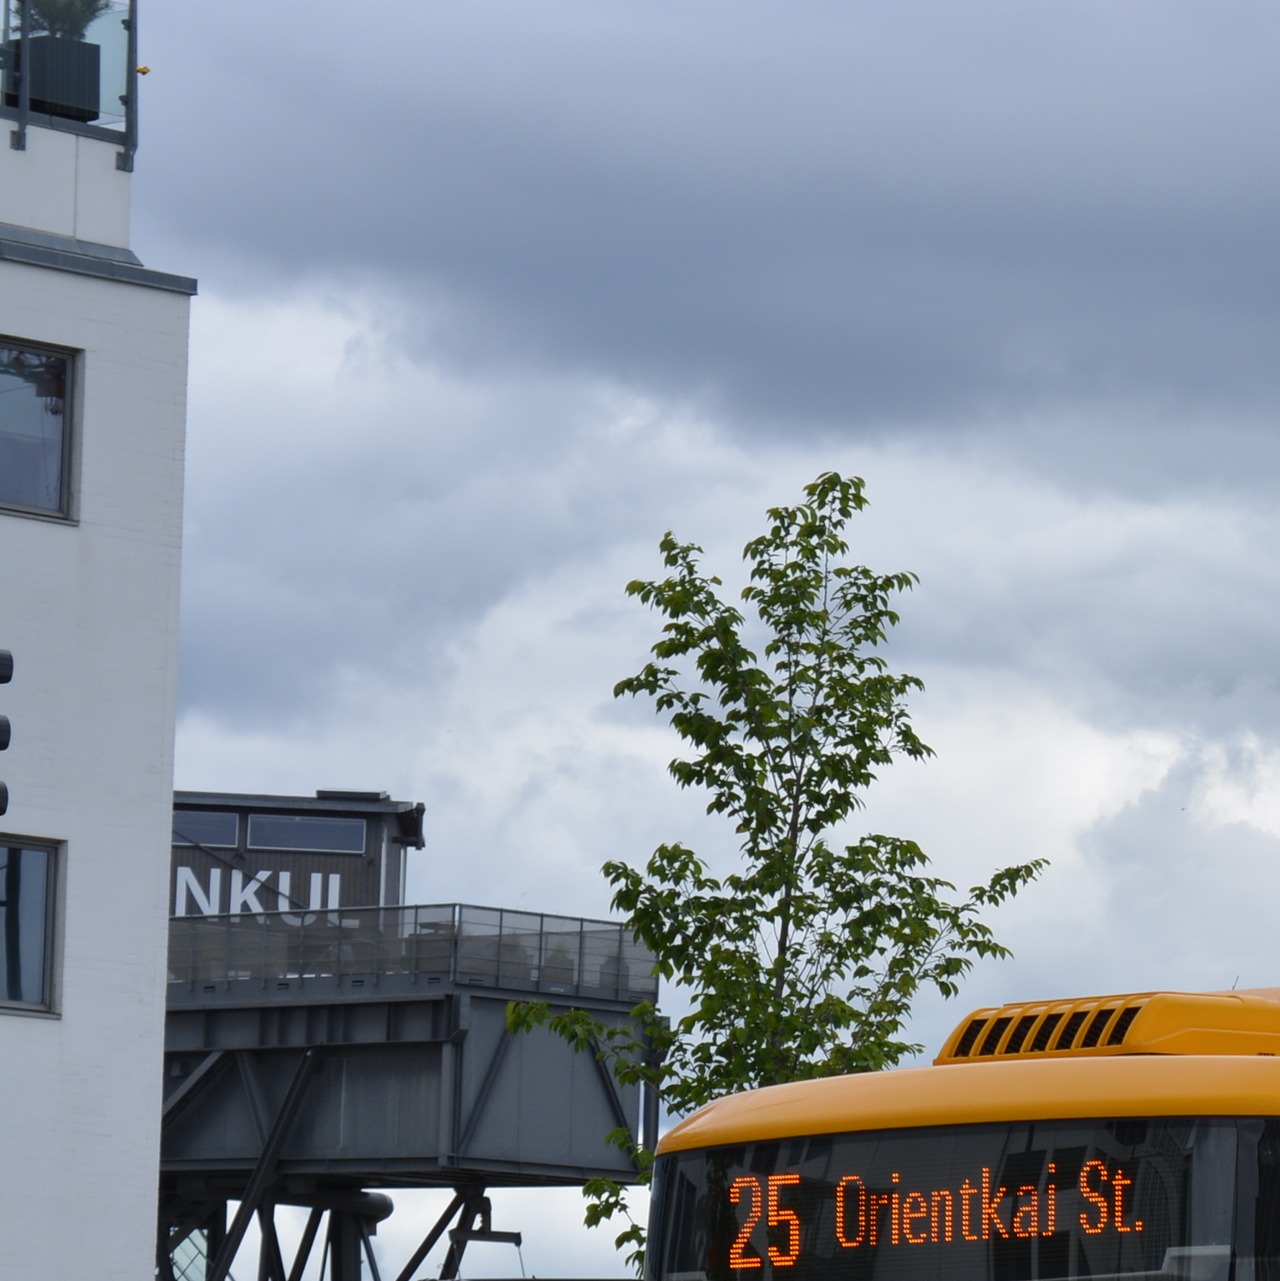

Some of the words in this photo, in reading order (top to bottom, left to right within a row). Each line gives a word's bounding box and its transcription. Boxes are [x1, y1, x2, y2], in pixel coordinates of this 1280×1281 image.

[730, 1174, 800, 1269] 25
[834, 1162, 1057, 1248] Orientkaj
[1080, 1160, 1143, 1235] St.
